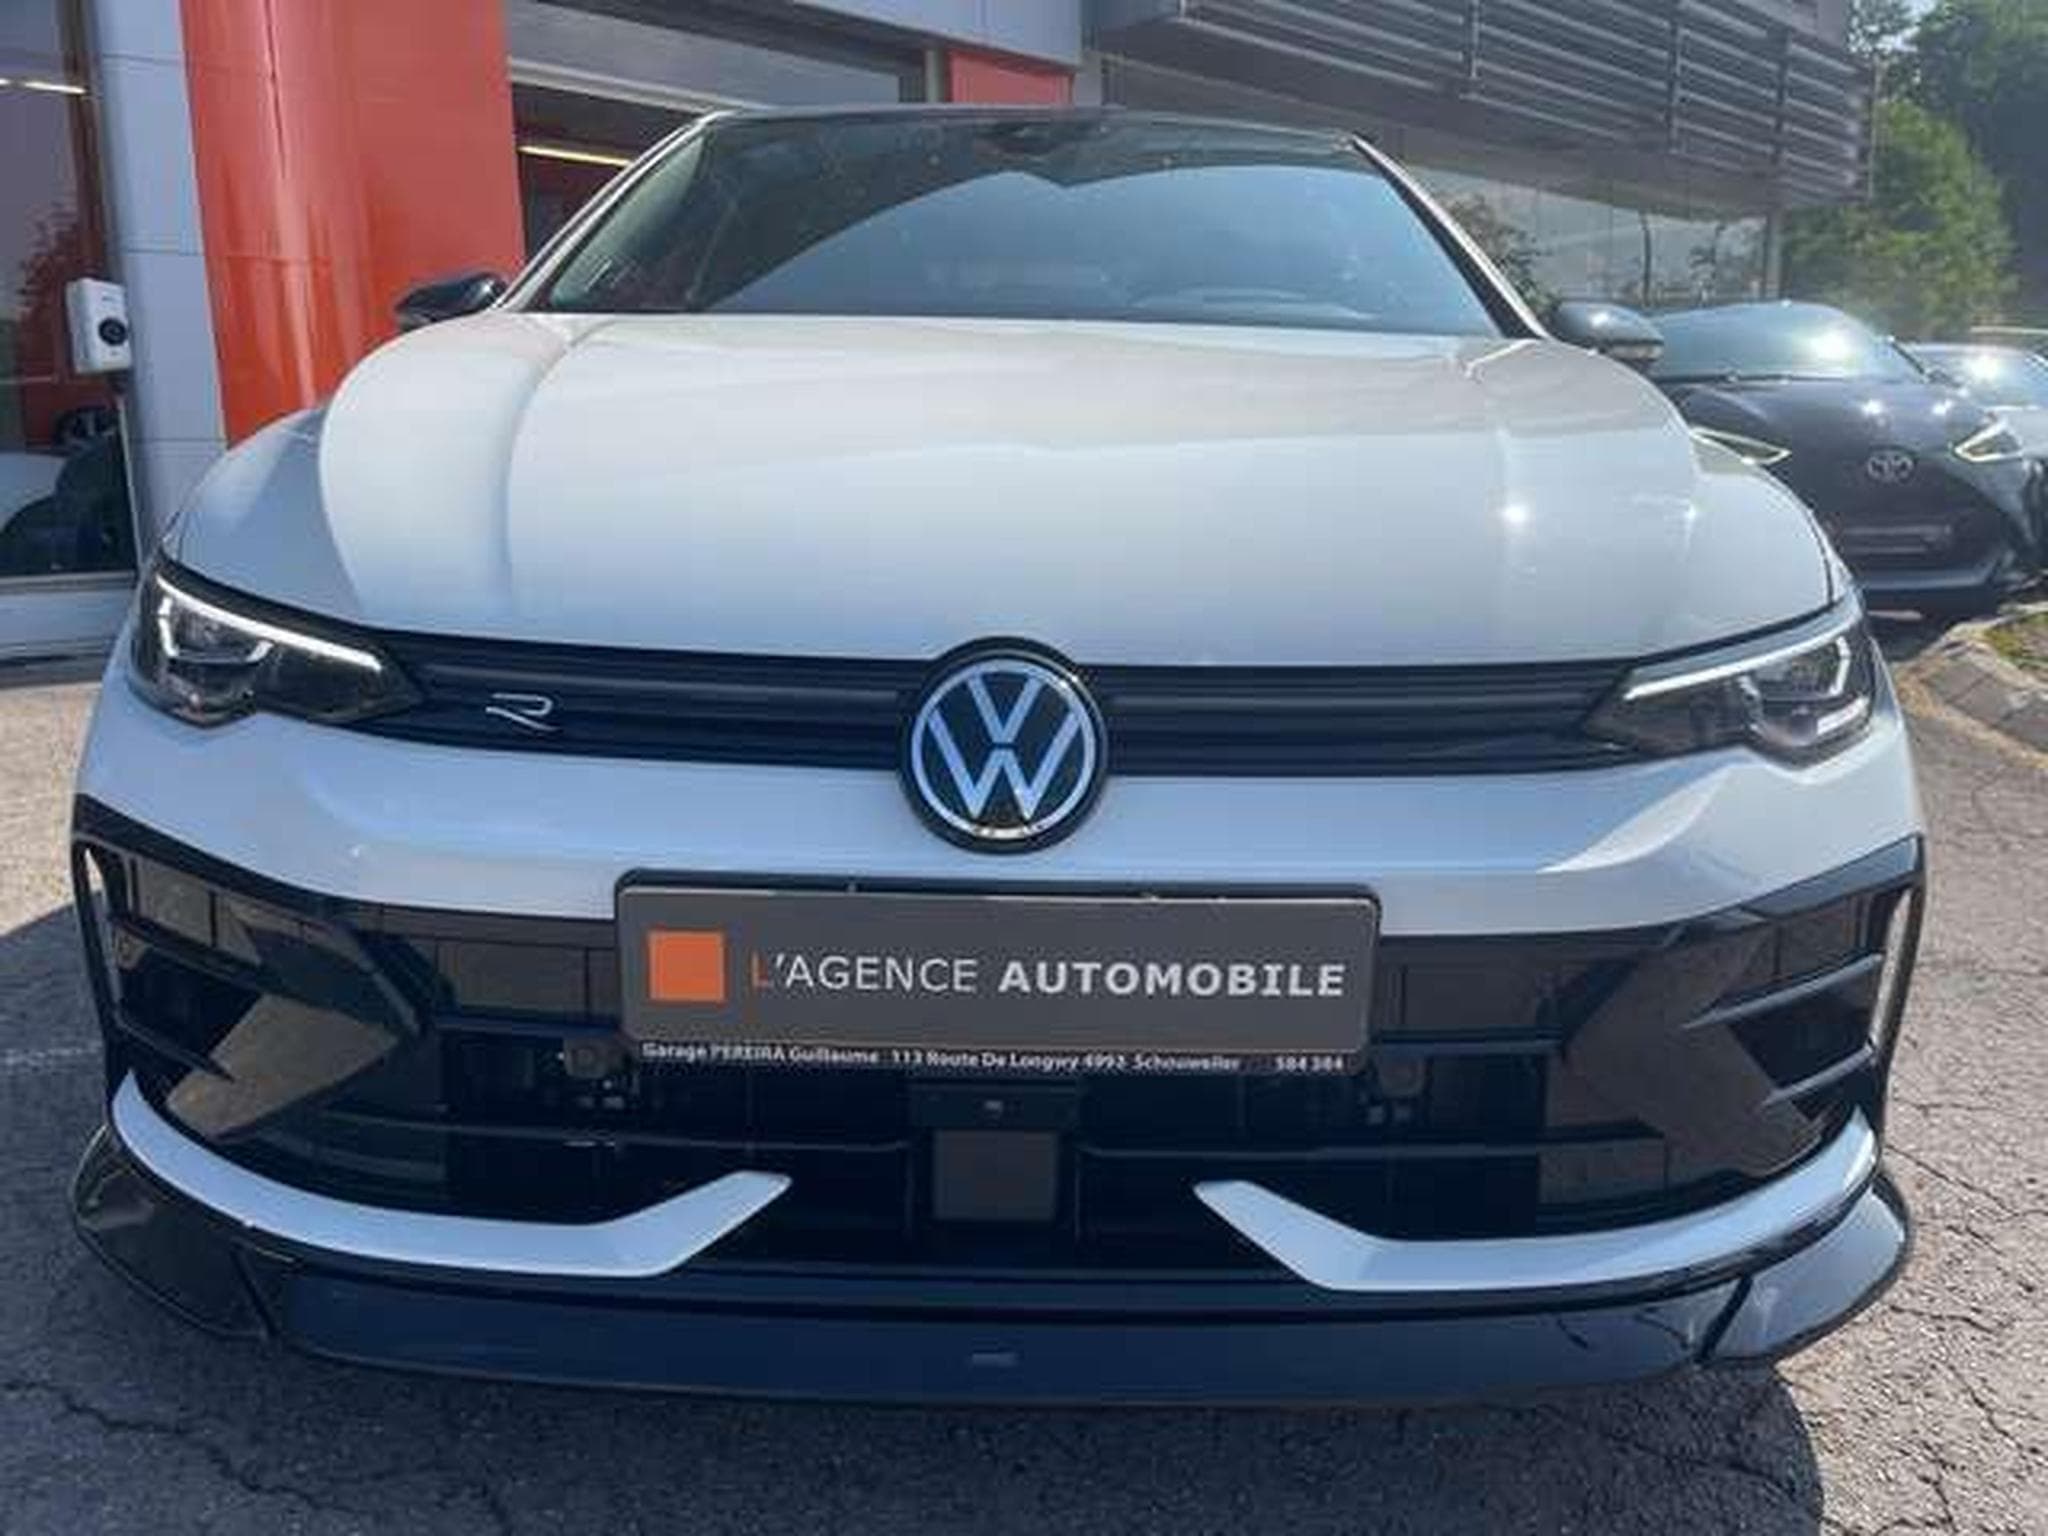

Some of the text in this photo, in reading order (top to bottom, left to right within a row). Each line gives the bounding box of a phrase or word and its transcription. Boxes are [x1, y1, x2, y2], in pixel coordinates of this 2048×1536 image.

[752, 953, 1347, 997] L'AGENCE AUTOMOBILE
[642, 1042, 707, 1063] Garage
[711, 1044, 784, 1062] PEREIRA
[926, 1050, 979, 1068] Route
[981, 1051, 1006, 1068] De
